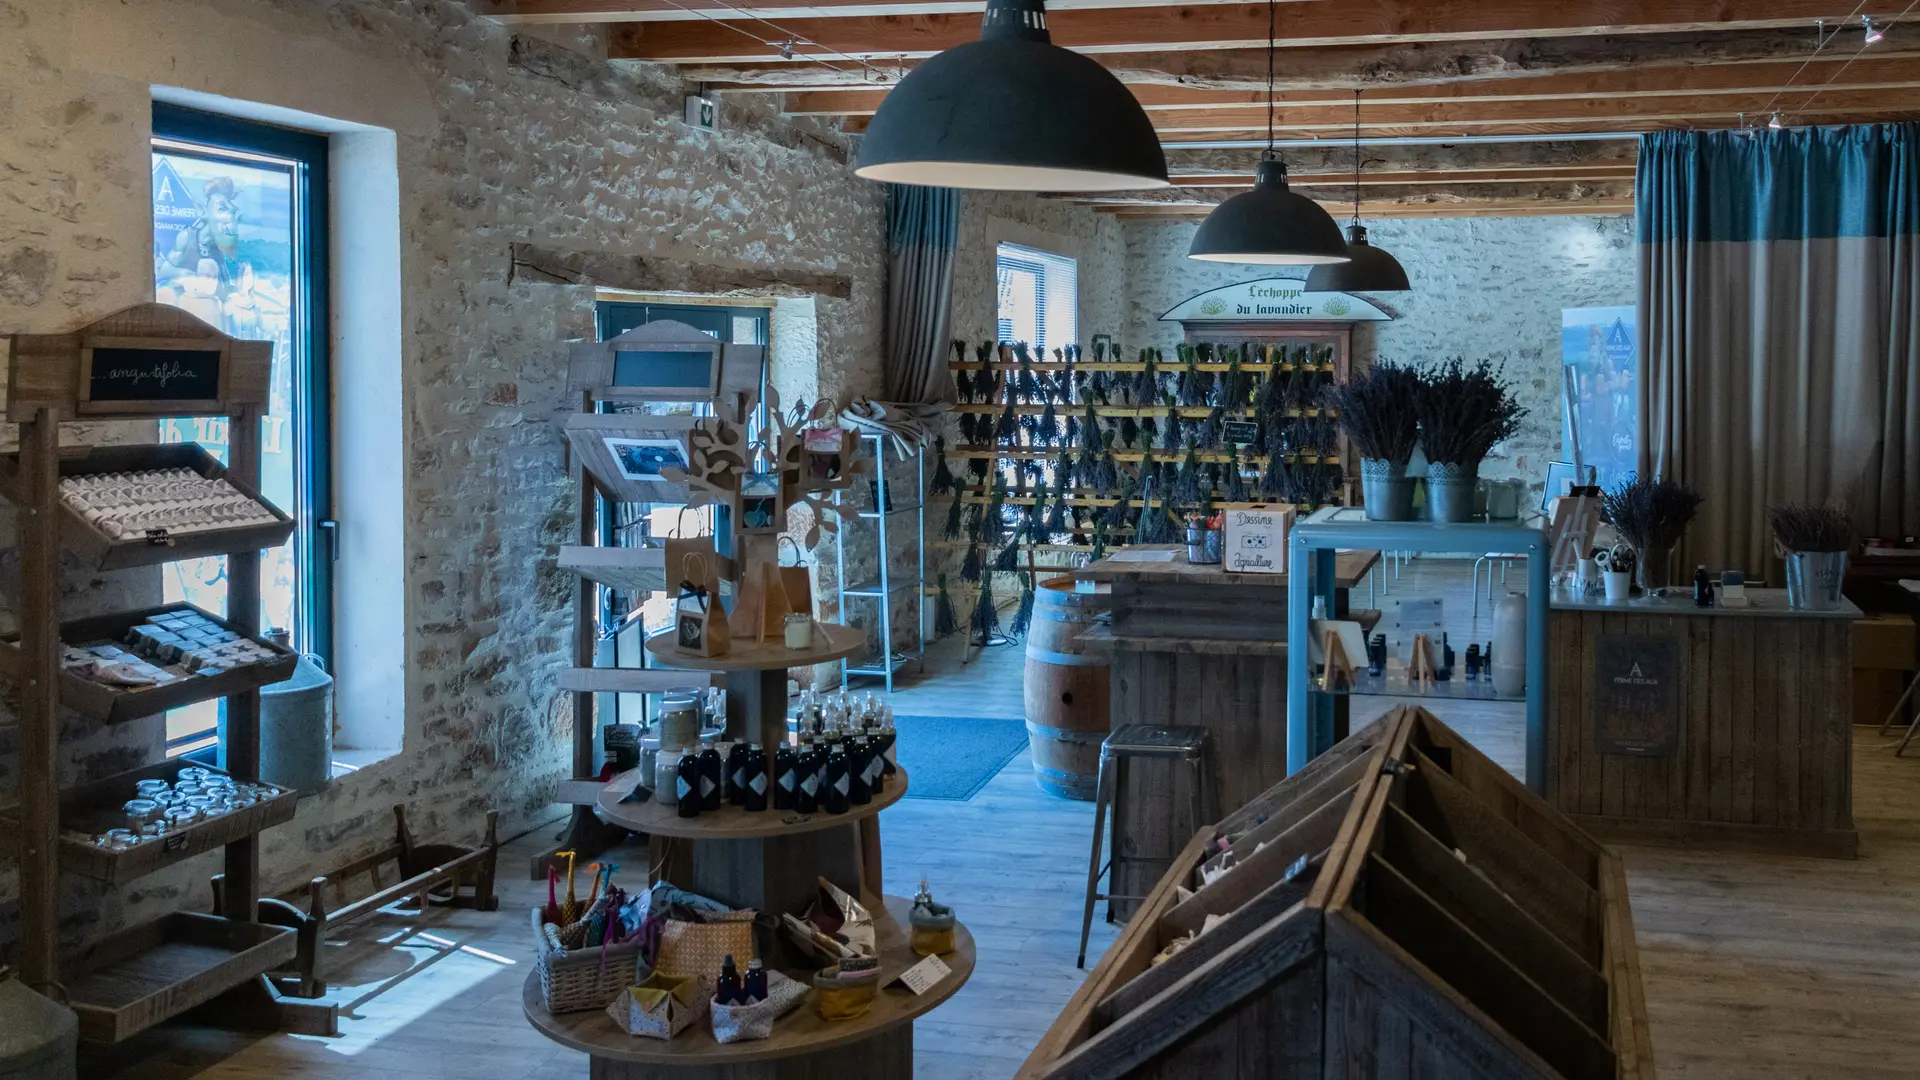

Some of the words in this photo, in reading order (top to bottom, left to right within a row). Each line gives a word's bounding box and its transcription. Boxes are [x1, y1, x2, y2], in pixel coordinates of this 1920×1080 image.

[1236, 303, 1251, 315] du
[1256, 303, 1312, 315] lavandier
[1236, 512, 1273, 526] Dessine
